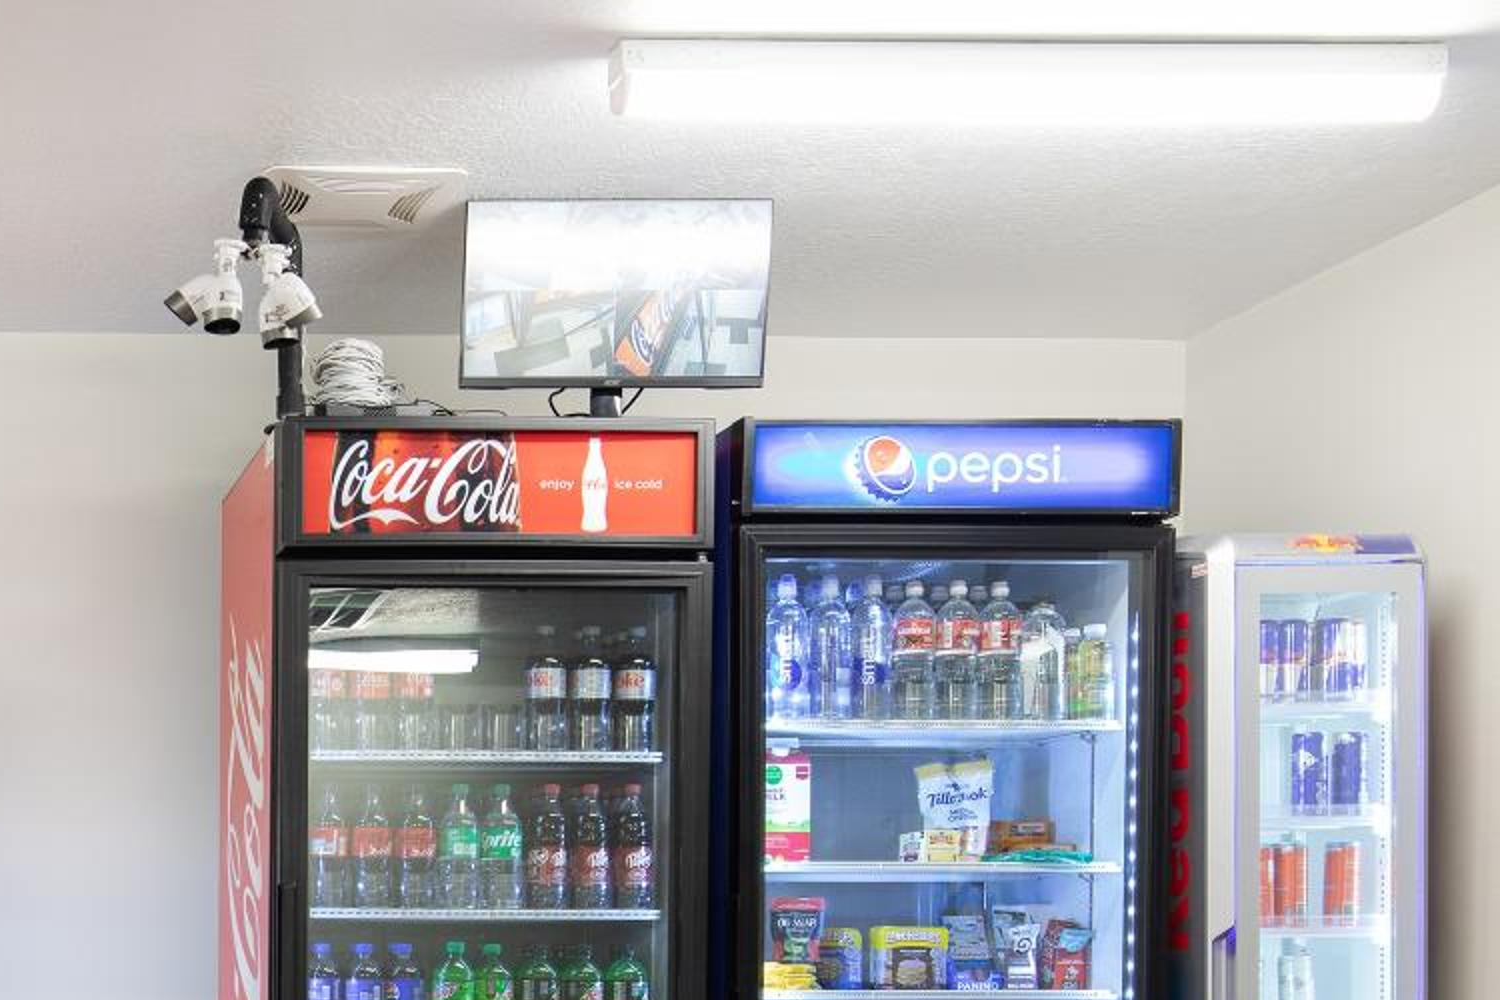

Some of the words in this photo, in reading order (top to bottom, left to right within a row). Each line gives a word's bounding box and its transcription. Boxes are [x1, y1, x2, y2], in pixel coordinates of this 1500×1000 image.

[329, 437, 521, 529] Coca-Cola
[614, 479, 632, 489] ice
[635, 479, 663, 489] cold
[925, 445, 1062, 493] pepsi
[539, 479, 574, 491] enjoy
